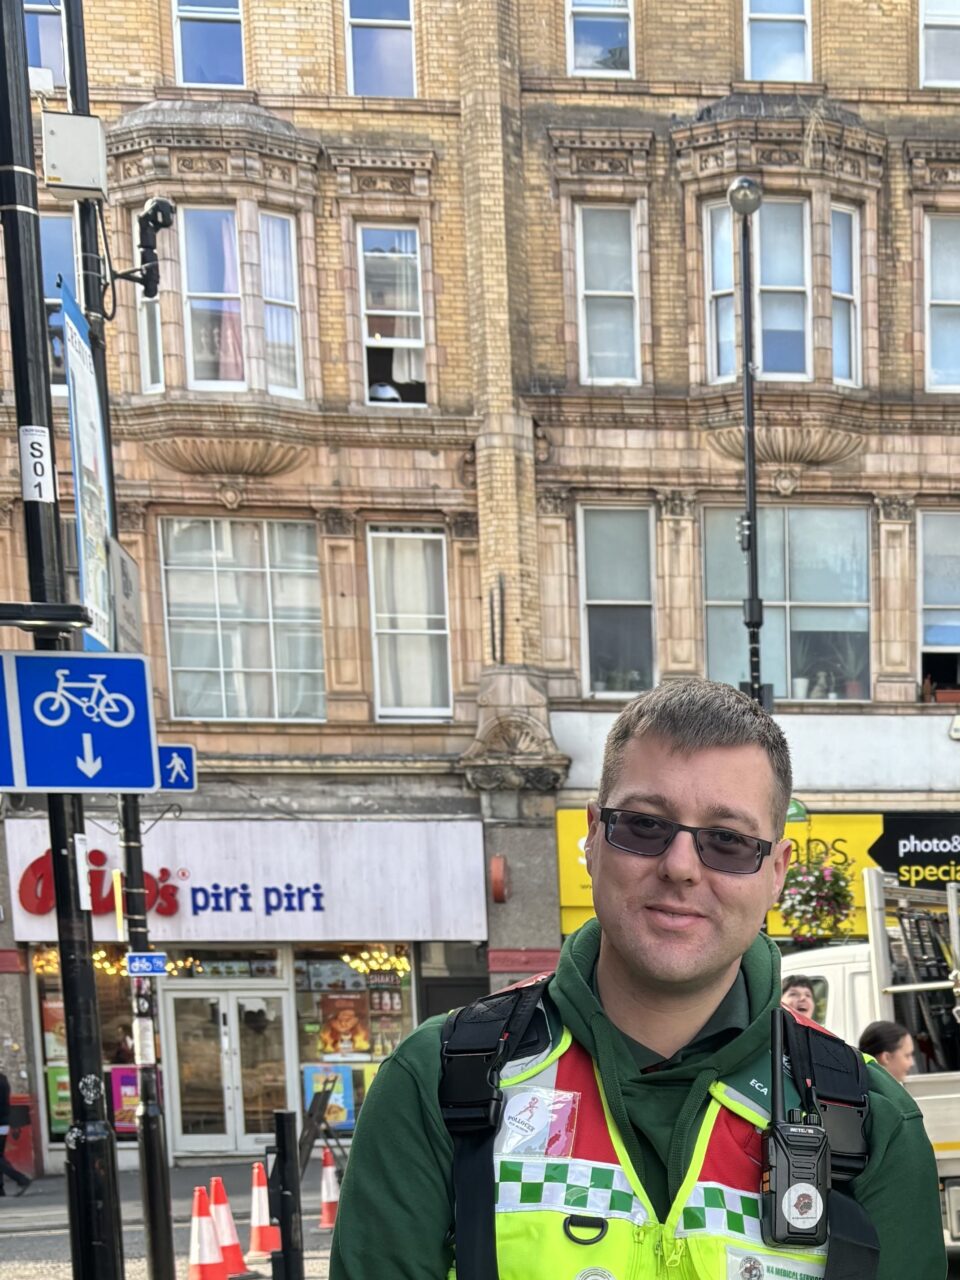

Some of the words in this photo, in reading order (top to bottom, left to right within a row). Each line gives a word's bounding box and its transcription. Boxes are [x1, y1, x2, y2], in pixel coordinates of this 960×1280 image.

[191, 883, 252, 915] piri
[264, 883, 325, 915] piri
[749, 1078, 769, 1096] ECA
